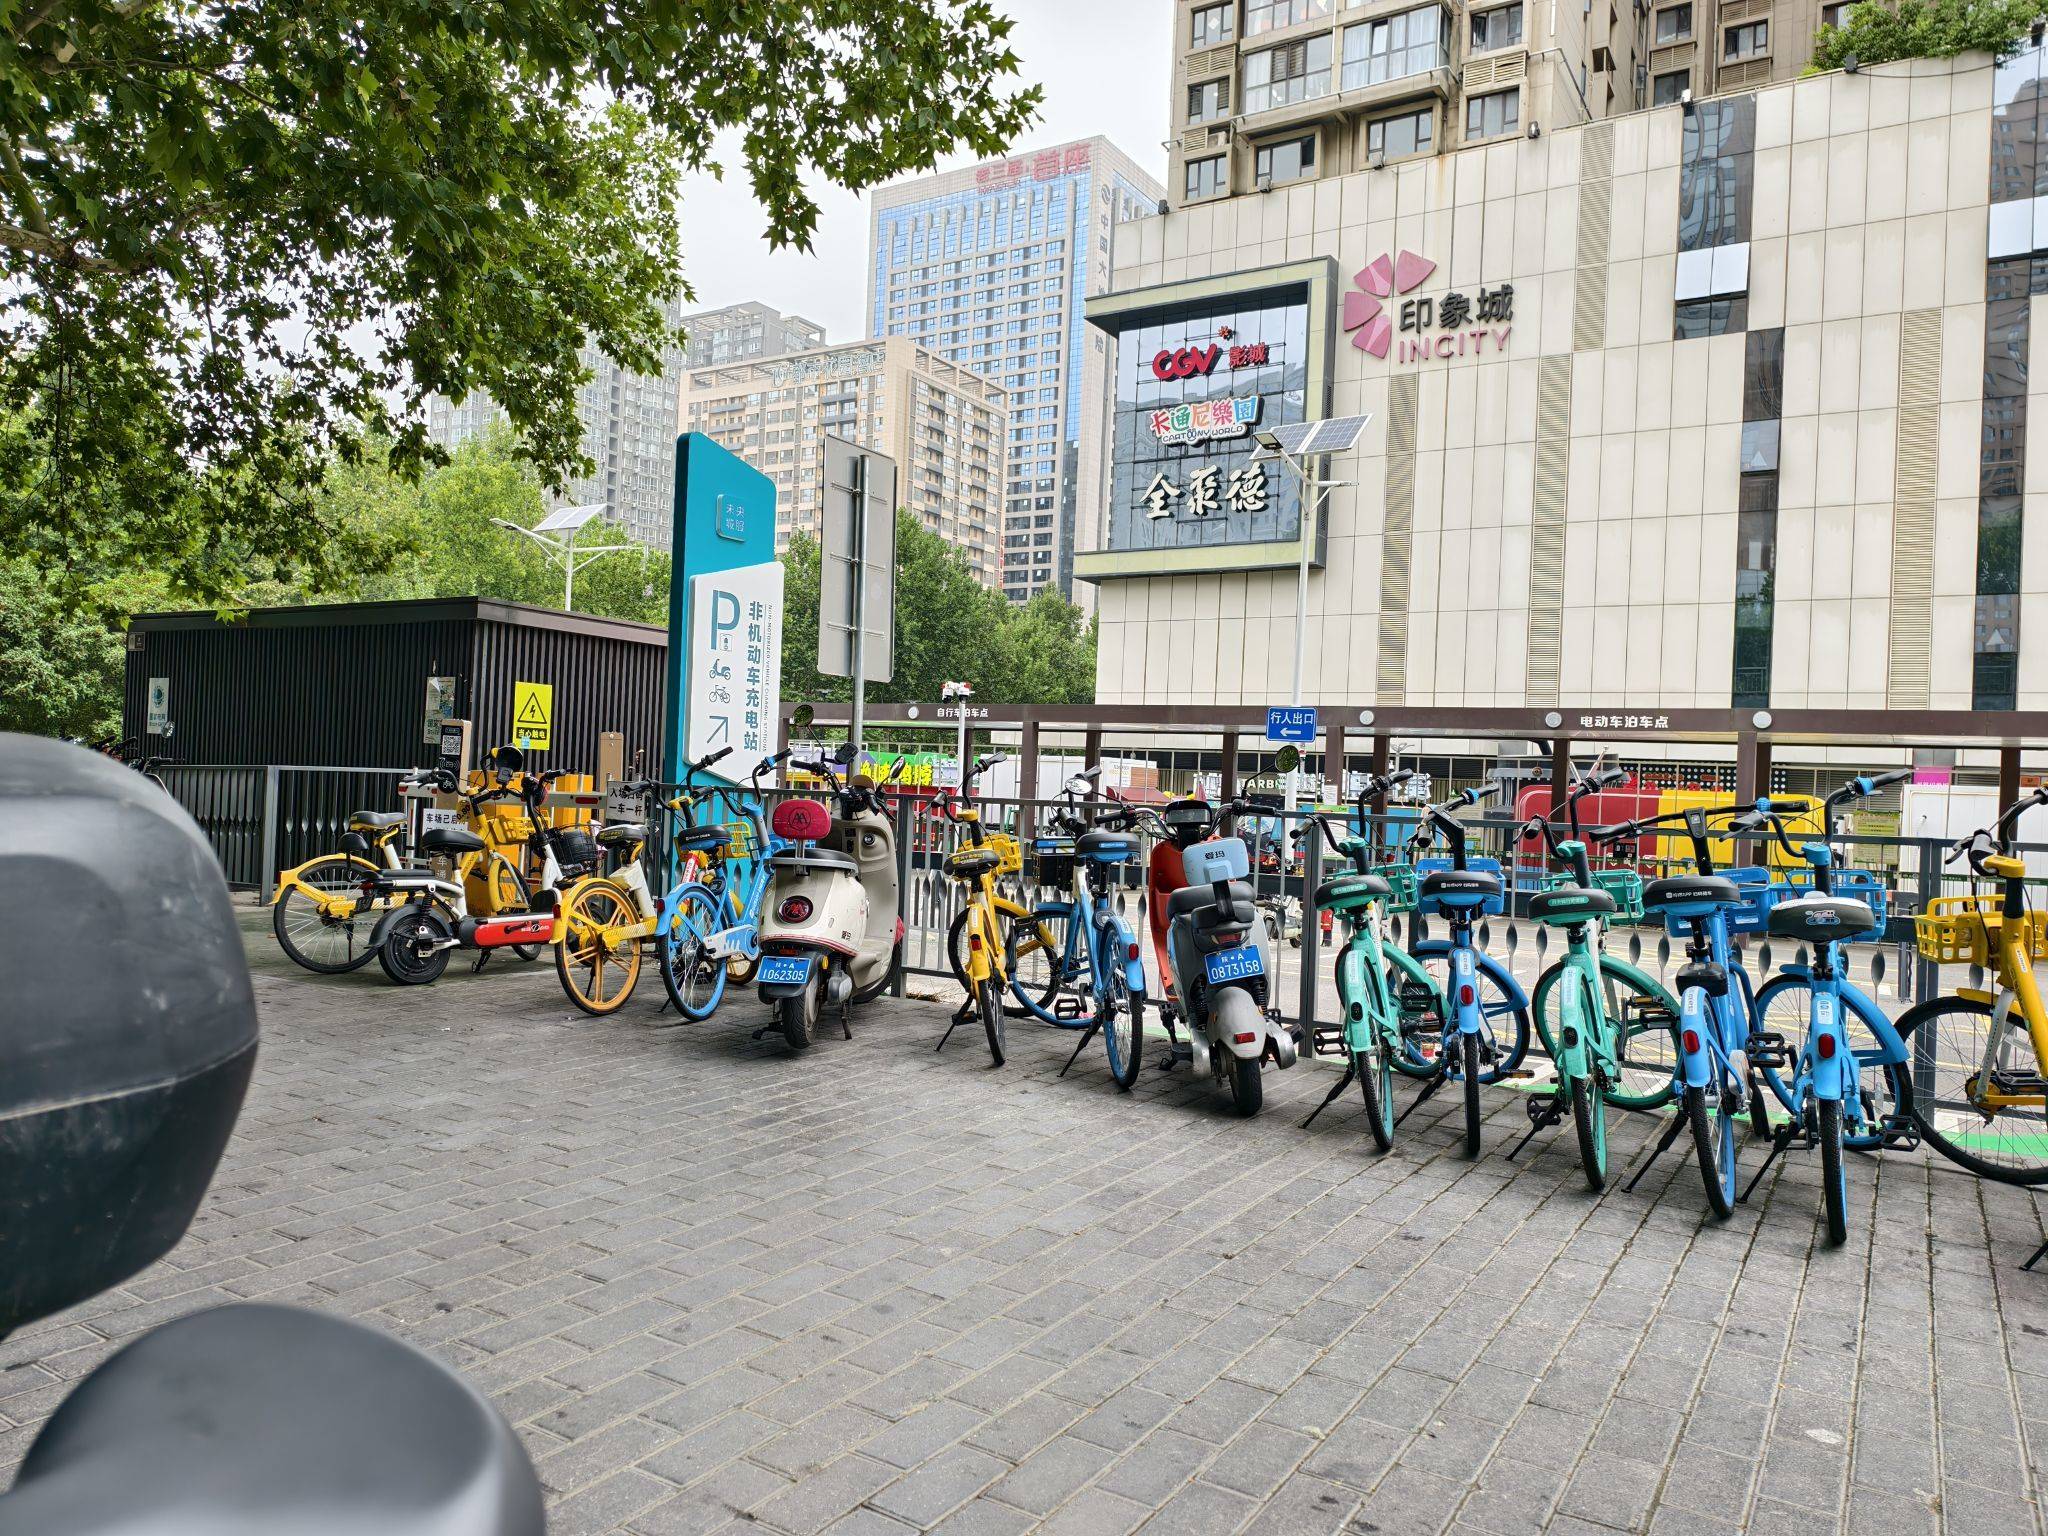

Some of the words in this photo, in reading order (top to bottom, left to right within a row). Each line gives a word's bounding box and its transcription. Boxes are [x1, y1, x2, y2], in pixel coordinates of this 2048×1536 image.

[1399, 284, 1514, 334] 印象城
[1398, 326, 1514, 364] INCITY
[1152, 343, 1218, 381] CGV
[1229, 342, 1270, 368] 影城
[1151, 396, 1259, 435] 卡通尼樂園
[1211, 425, 1244, 437] WORLD
[1140, 461, 1268, 519] 全聚德
[711, 589, 741, 651] P
[743, 600, 763, 752] 非机动车充电站
[937, 708, 989, 718] 自行车泊车点
[1270, 711, 1315, 725] 行人出口
[1580, 715, 1669, 728] 电动车泊车点
[518, 728, 546, 739] 当心触电
[609, 803, 643, 816] 一车一杆
[762, 969, 805, 981] 1062305
[1211, 959, 1261, 980] 0873158
